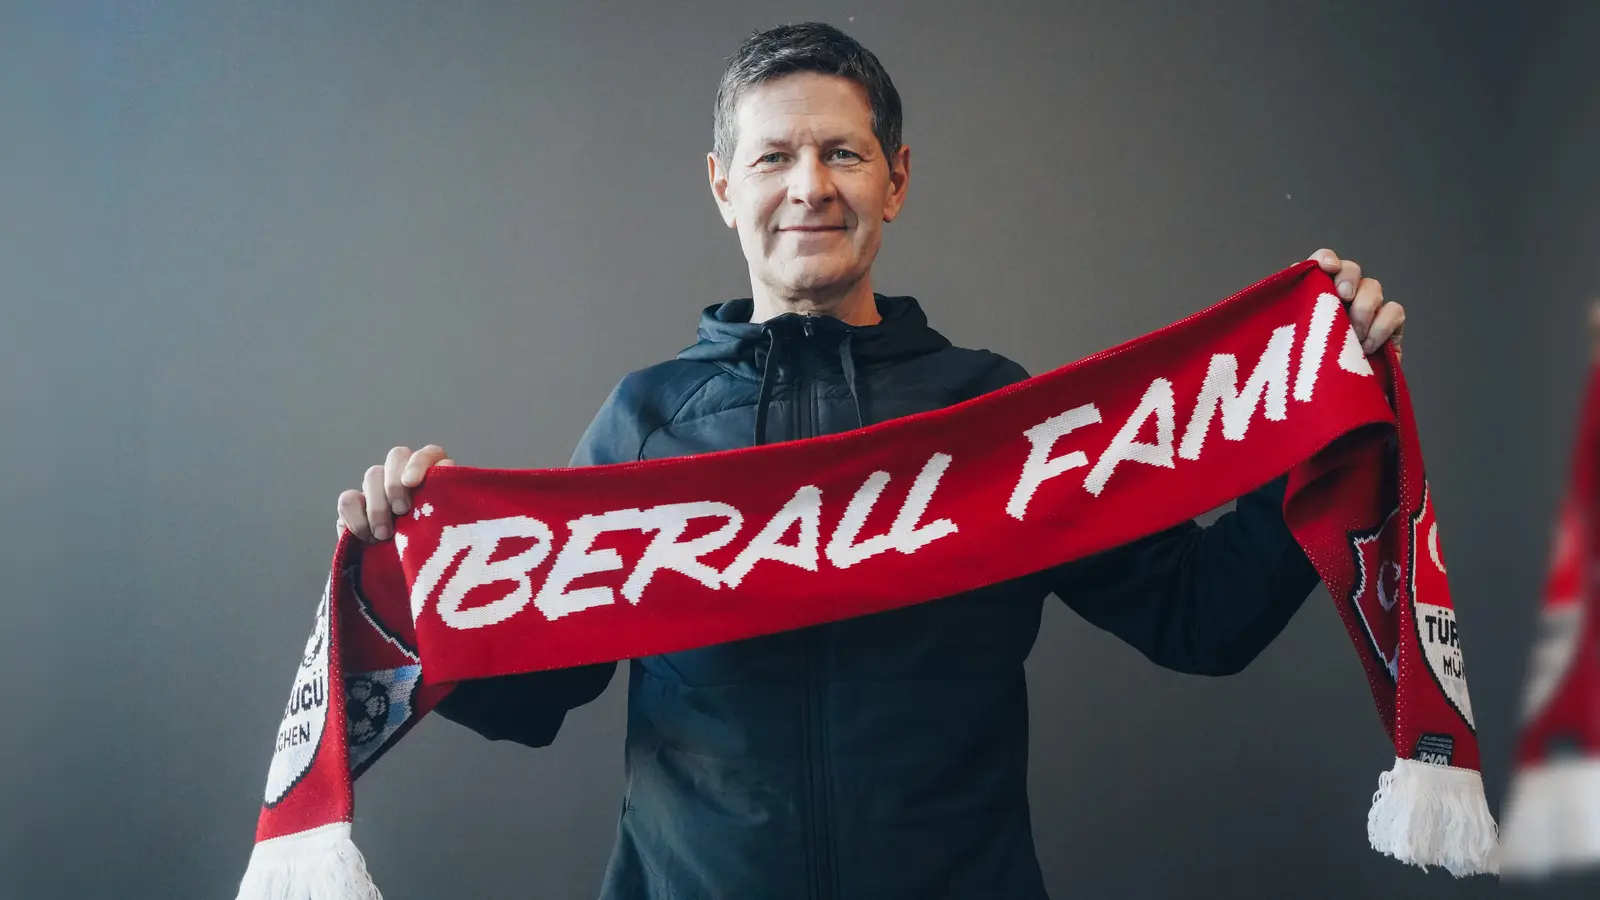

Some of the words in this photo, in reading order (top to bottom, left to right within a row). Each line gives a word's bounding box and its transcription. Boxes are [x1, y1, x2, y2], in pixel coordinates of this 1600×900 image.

[1443, 650, 1465, 681] MÜ
[285, 668, 324, 720] ÜCÜ
[276, 721, 310, 752] CHEN
